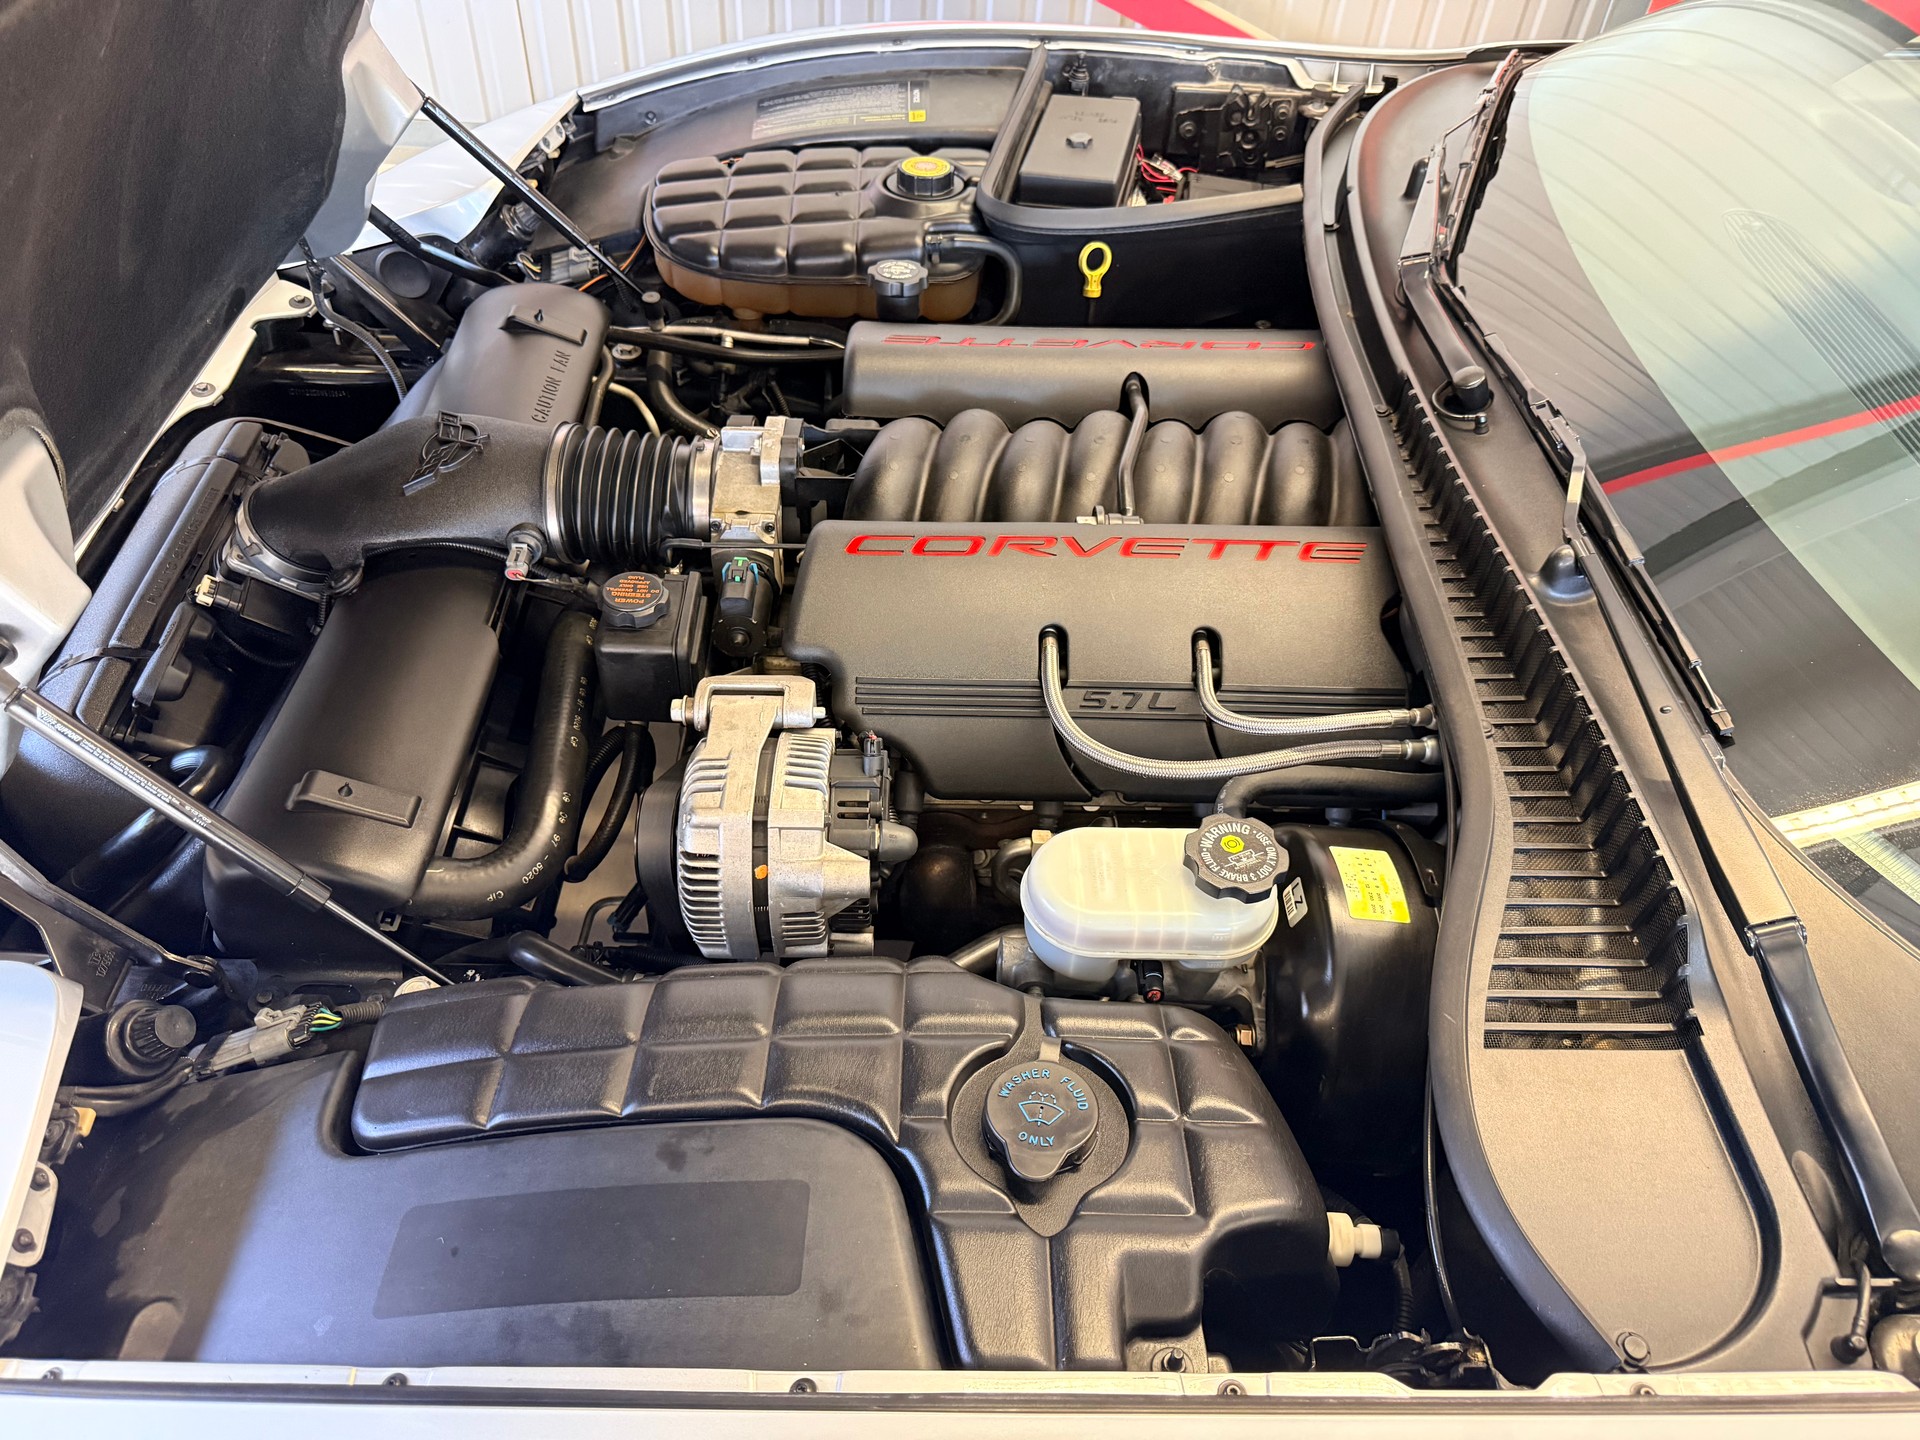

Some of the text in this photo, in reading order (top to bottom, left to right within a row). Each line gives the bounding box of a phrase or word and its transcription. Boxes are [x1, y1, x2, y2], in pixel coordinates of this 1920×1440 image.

[881, 335, 1317, 351] CORVETTE
[531, 376, 562, 423] CAUTION
[844, 534, 1369, 564] CORVETTE
[1079, 690, 1177, 710] 5.7L
[54, 721, 83, 743] SUPPORT
[551, 833, 561, 848] 97
[1200, 822, 1251, 848] WARNING
[1255, 831, 1272, 846] USE
[1200, 851, 1221, 872] FLUID
[1265, 846, 1278, 866] ONLY
[521, 862, 544, 884] 5020
[1219, 869, 1249, 882] BRAKE
[1249, 872, 1257, 881] 3
[1256, 866, 1273, 879] DOT
[486, 890, 504, 902] CIP
[998, 1068, 1089, 1110] WASHER FLUID
[1018, 1131, 1055, 1147] ONLY
